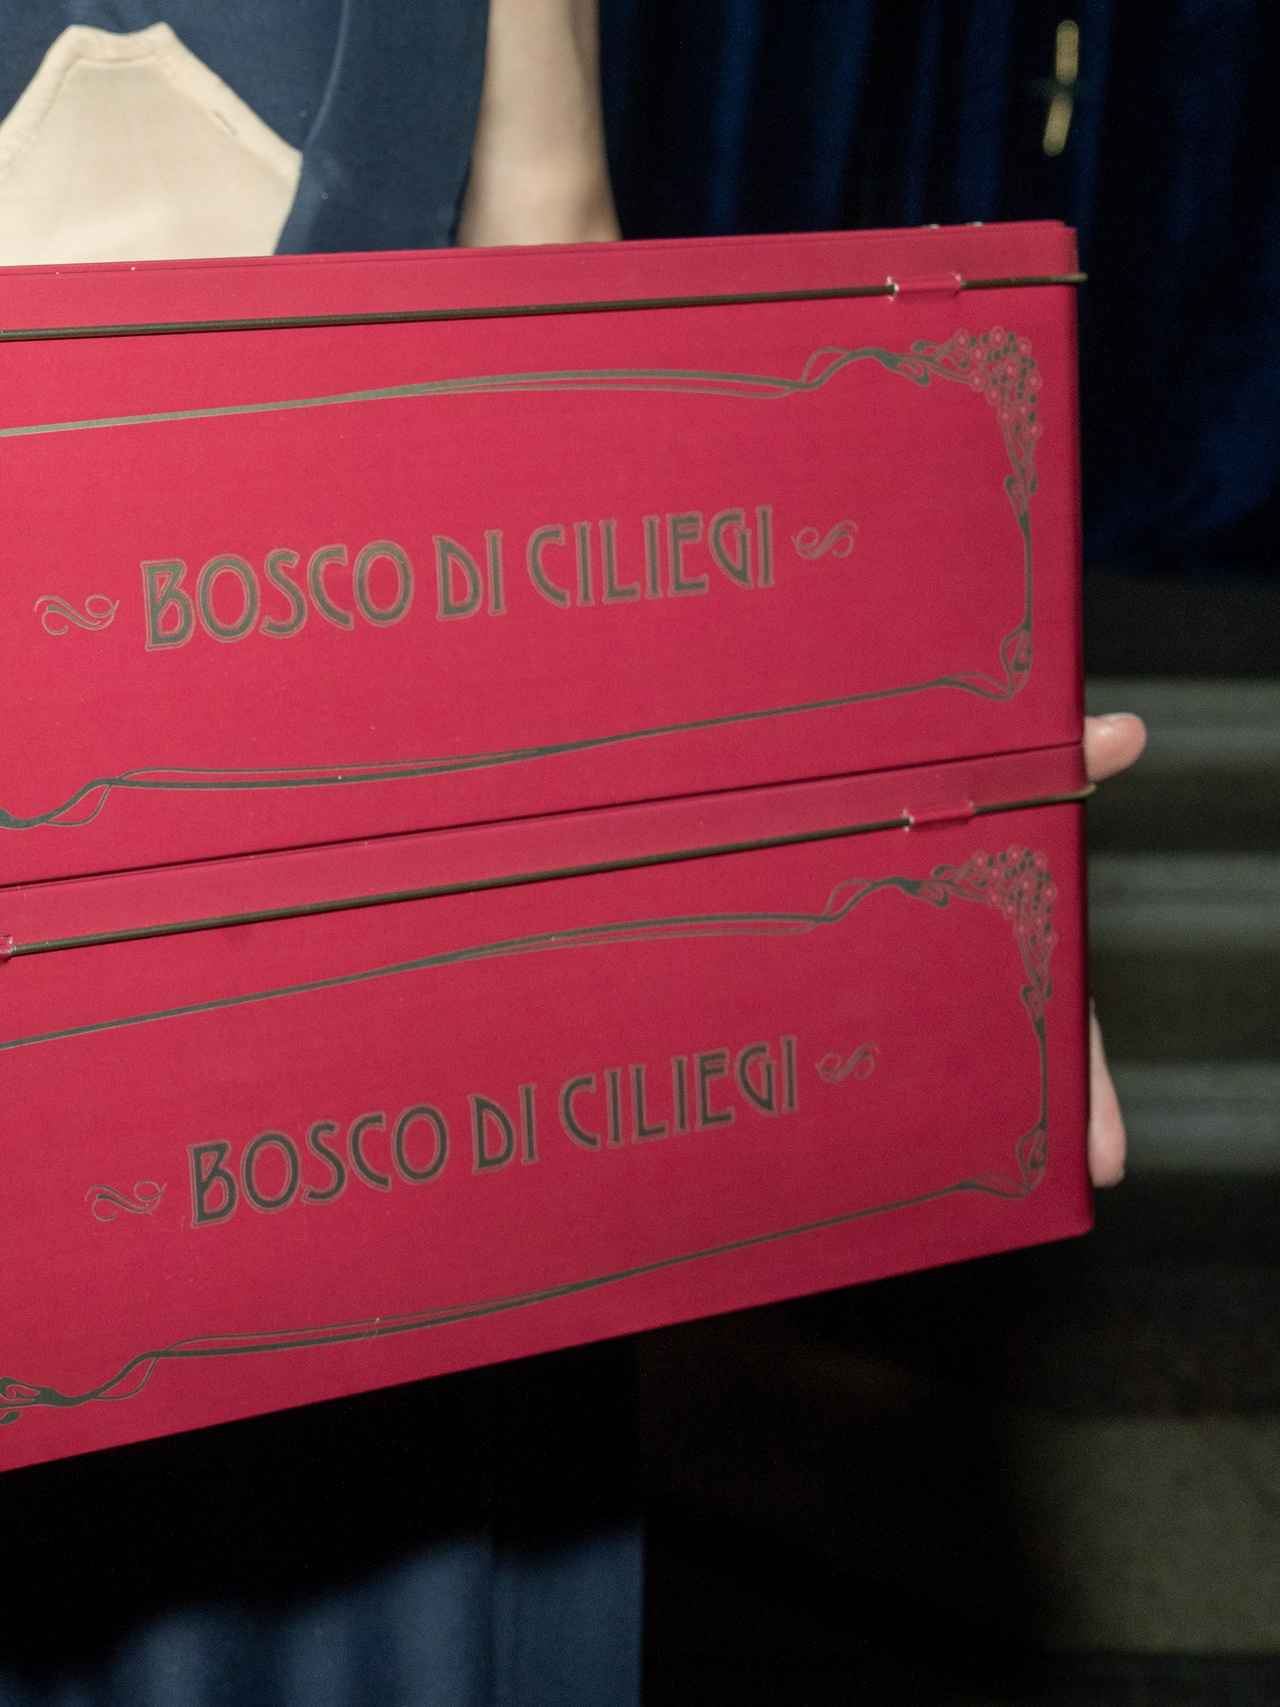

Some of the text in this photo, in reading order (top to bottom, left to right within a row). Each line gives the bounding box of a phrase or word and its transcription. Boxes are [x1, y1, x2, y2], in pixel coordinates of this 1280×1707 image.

[140, 505, 775, 652] BOSCO DI CILIEGI
[187, 1035, 799, 1229] BOSCO DI CILIEGI
